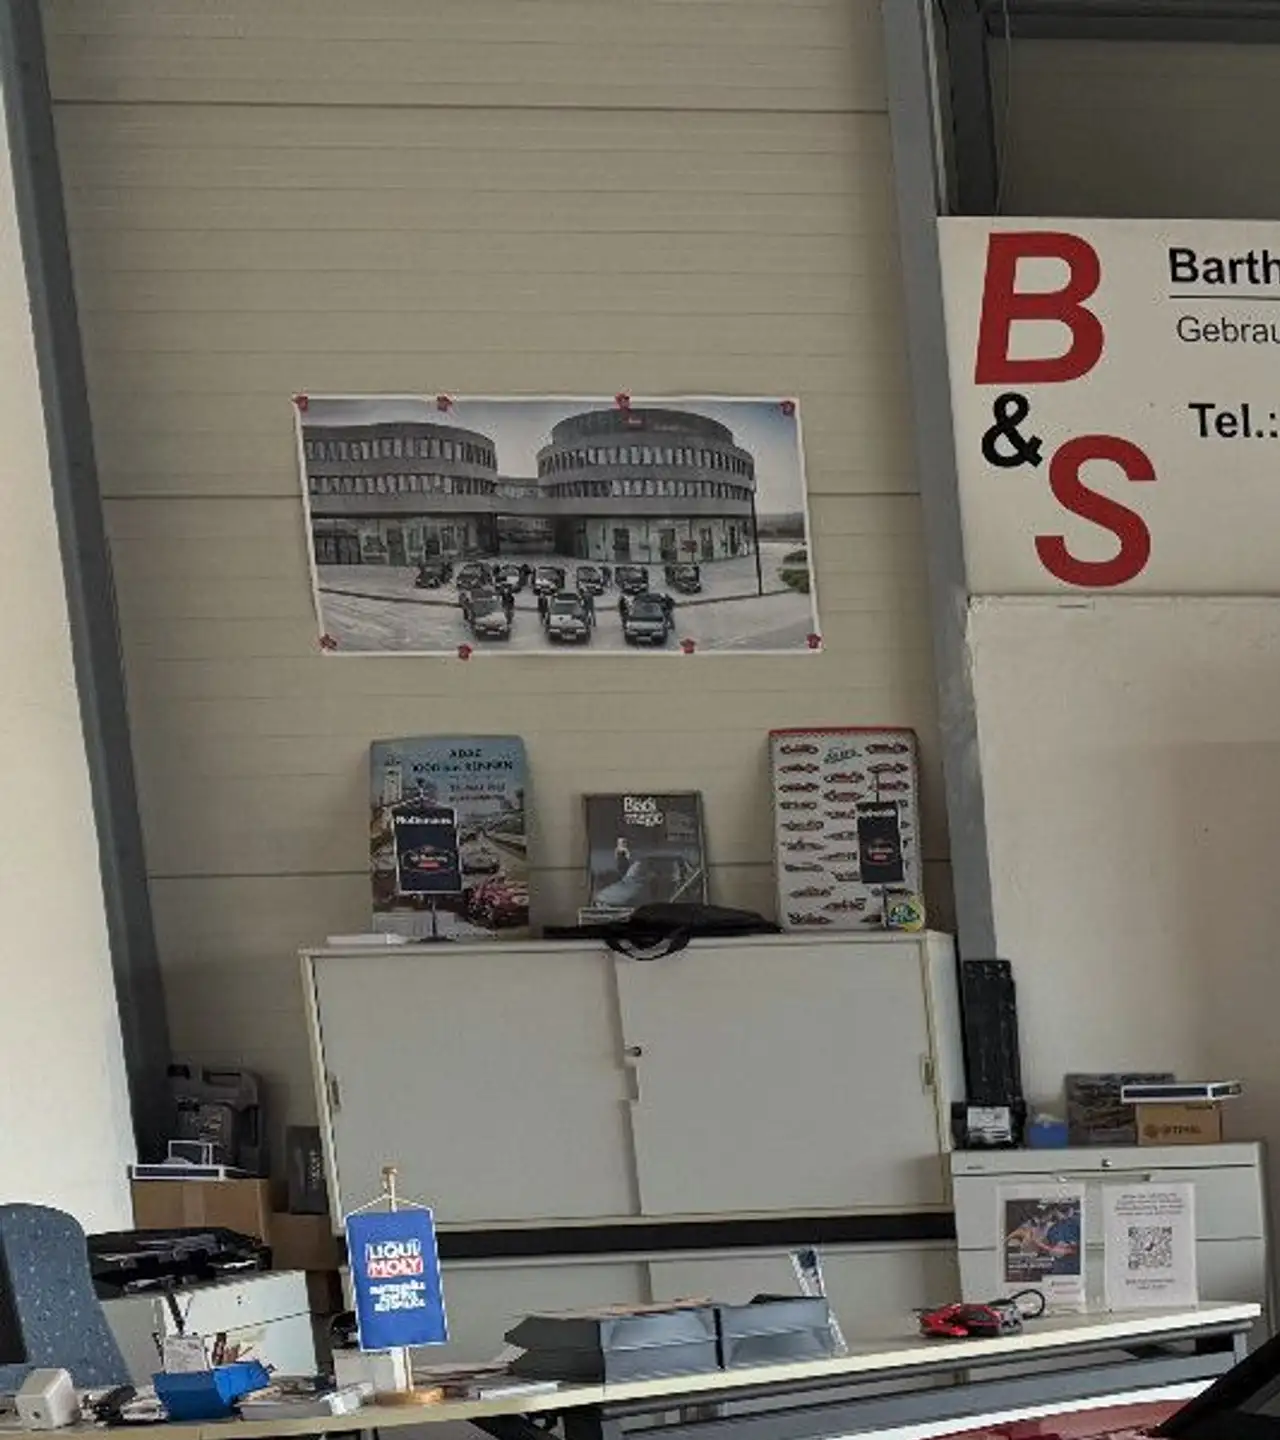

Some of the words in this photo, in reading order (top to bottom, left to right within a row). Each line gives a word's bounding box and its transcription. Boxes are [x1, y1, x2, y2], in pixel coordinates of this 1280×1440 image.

[975, 231, 1105, 385] B
[982, 392, 1043, 467] &
[1188, 402, 1278, 438] Tel.:
[1035, 434, 1158, 587] S
[368, 1257, 422, 1277] MOLY
[369, 1242, 420, 1260] LIQUI
